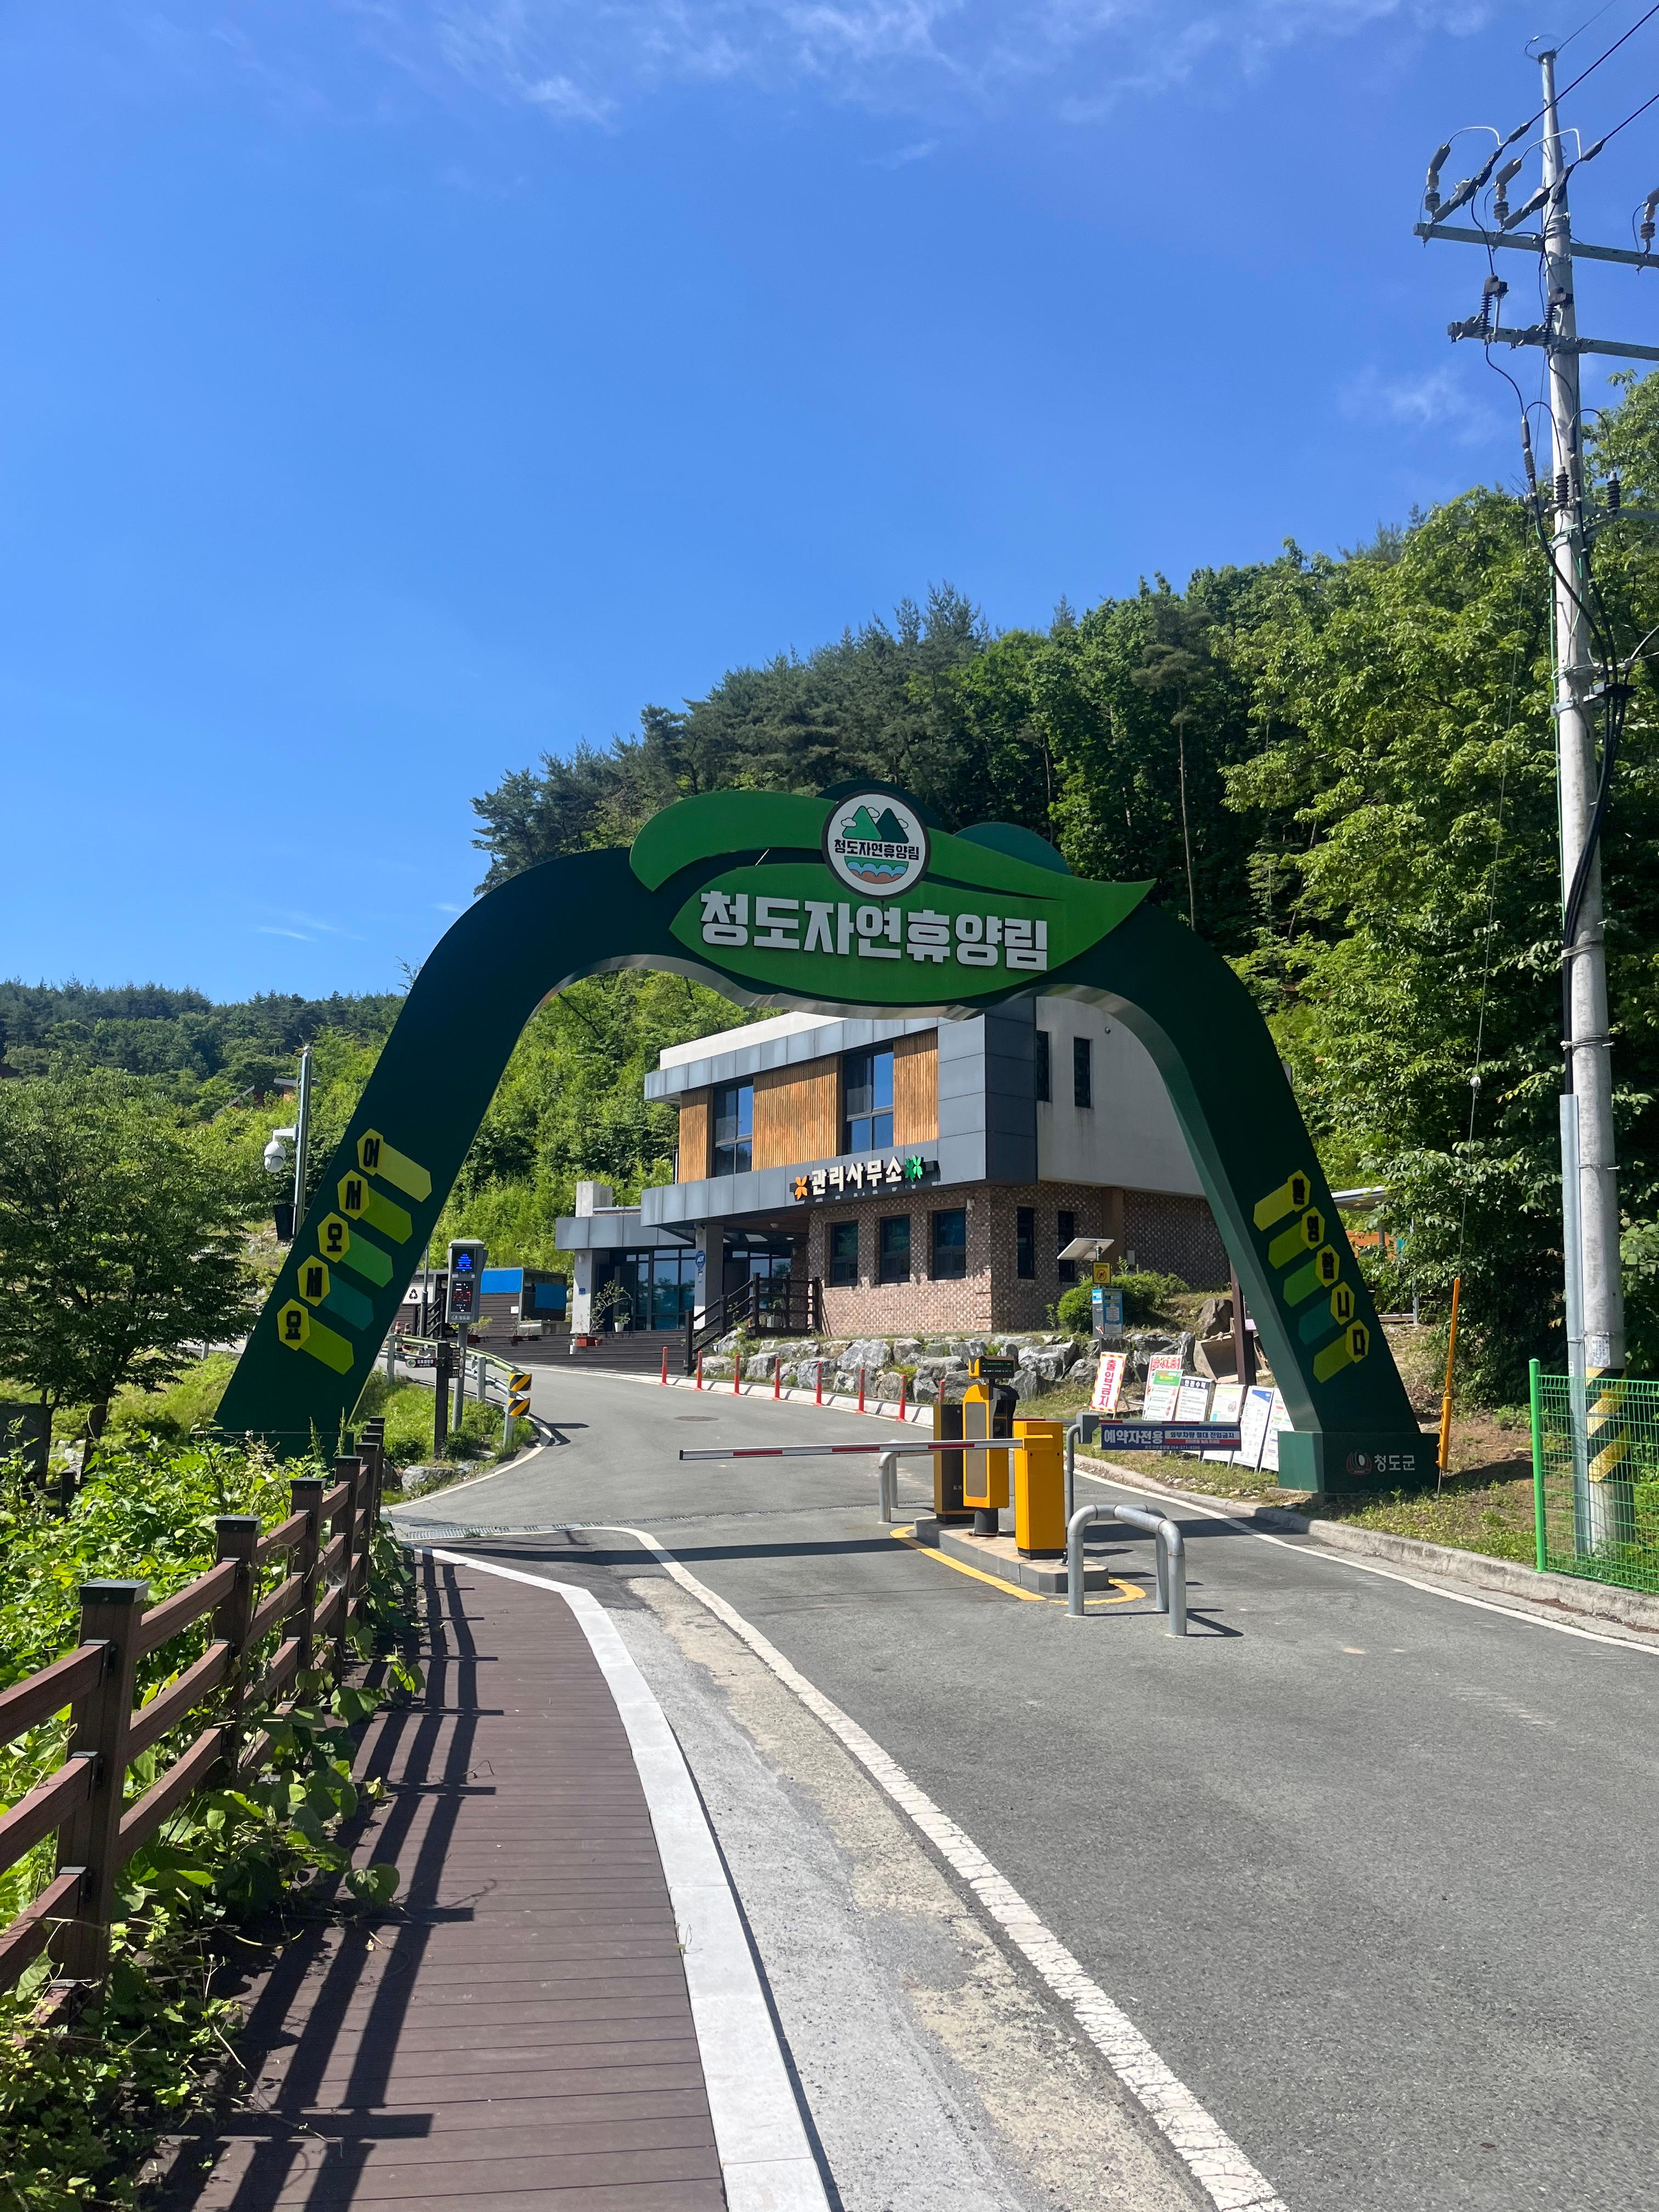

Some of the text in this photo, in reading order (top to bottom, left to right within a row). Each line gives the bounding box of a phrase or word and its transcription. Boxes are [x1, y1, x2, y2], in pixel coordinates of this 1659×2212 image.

[834, 839, 919, 861] 청도자연휴양림
[701, 890, 1047, 971] 청도자연휴양림
[811, 1156, 902, 1196] 관리사무소
[1153, 1359, 1177, 1369] 공사중
[1098, 1359, 1116, 1408] 출입금지
[1104, 1430, 1163, 1444] 예약자전용
[1374, 1454, 1415, 1472] 청도군
